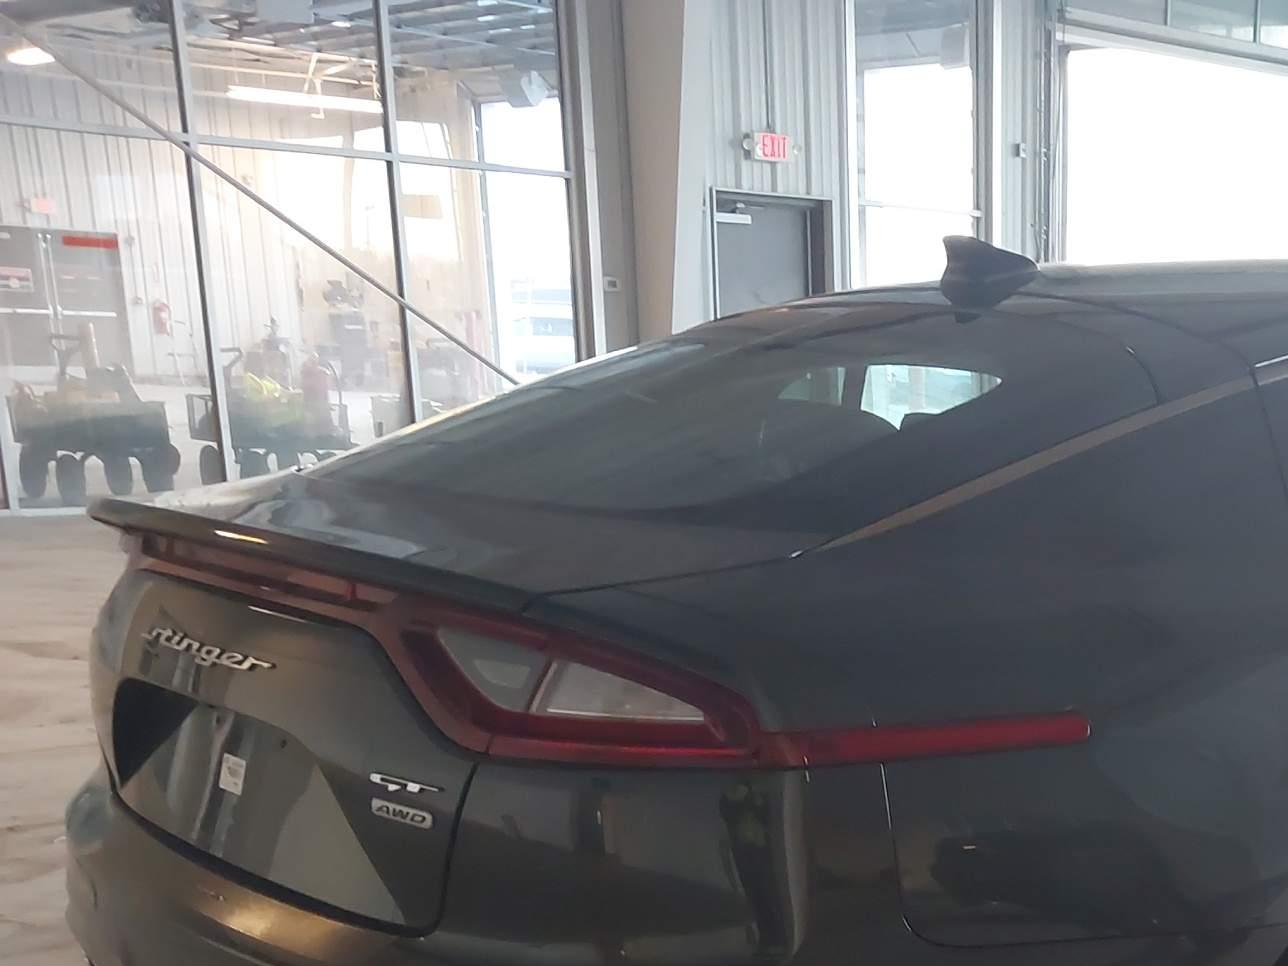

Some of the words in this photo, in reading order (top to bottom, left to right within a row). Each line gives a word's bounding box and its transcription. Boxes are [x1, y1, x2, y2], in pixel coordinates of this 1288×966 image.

[762, 134, 787, 159] EXIT
[369, 772, 440, 793] GT
[375, 803, 427, 825] AWD
